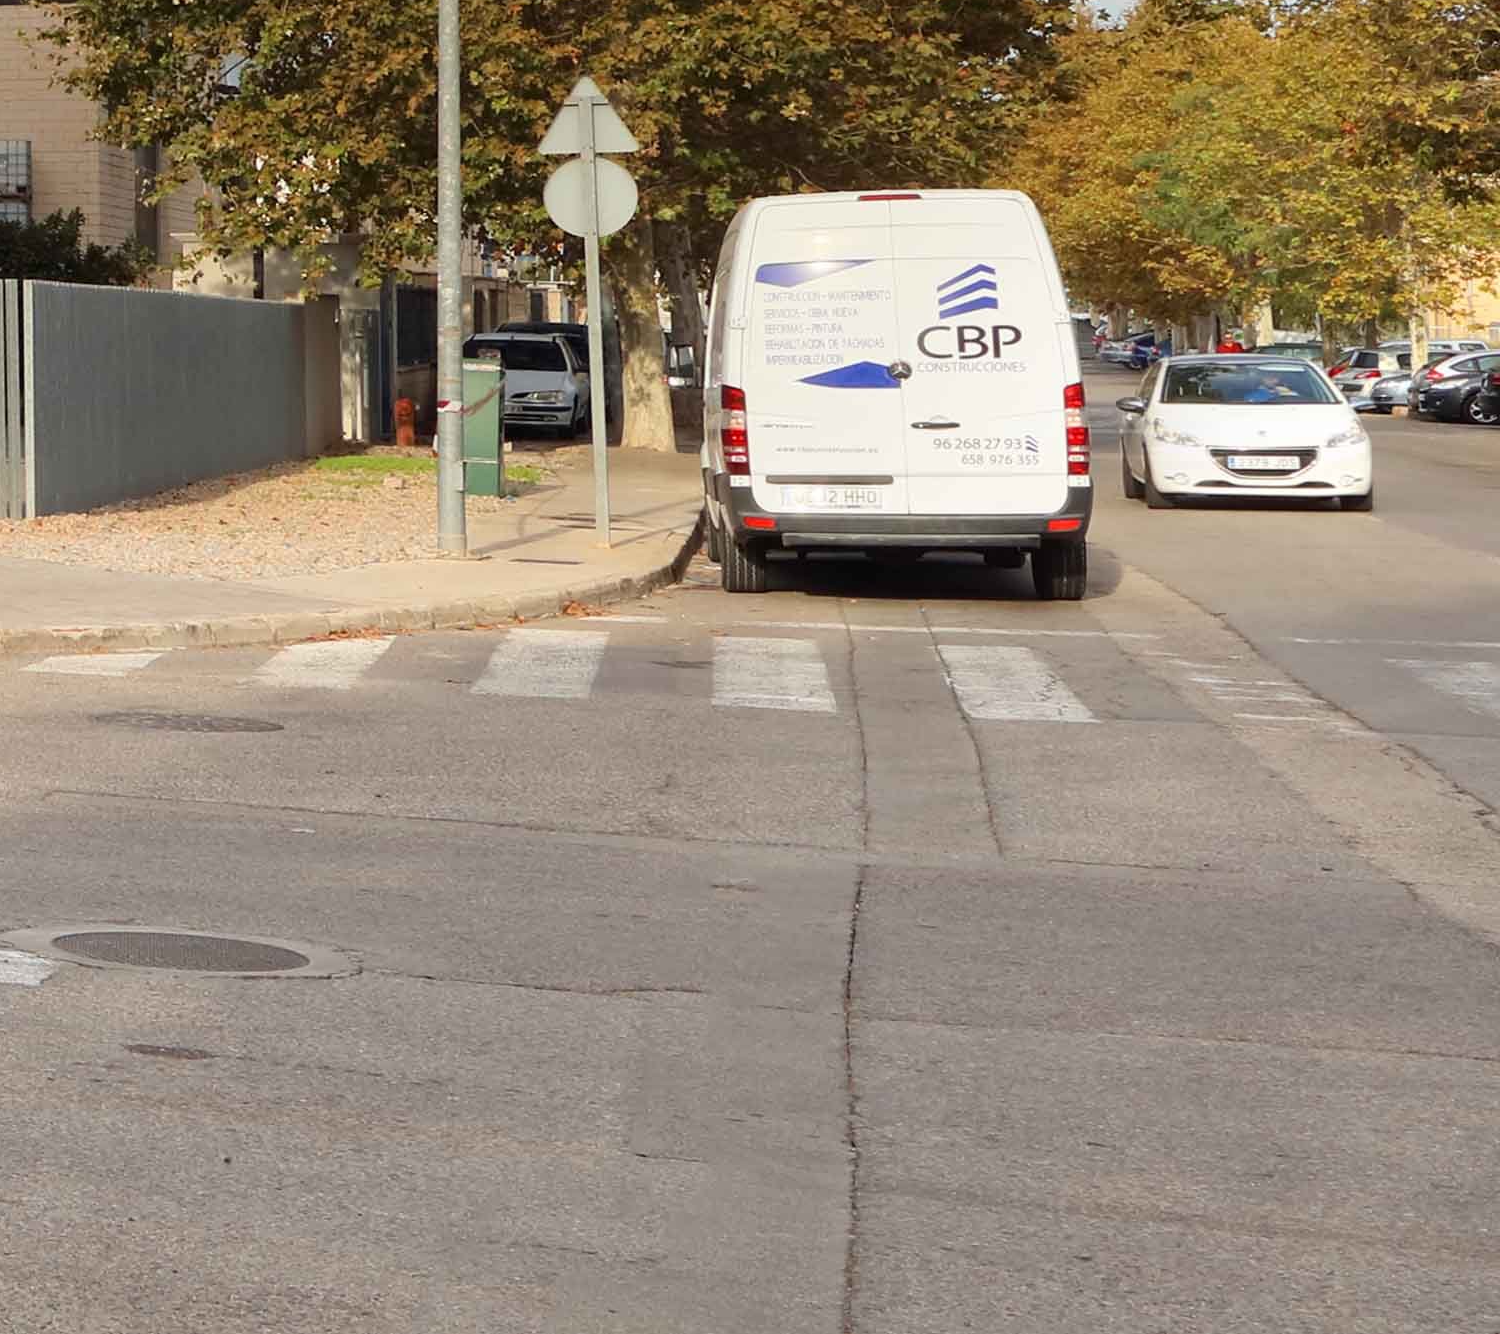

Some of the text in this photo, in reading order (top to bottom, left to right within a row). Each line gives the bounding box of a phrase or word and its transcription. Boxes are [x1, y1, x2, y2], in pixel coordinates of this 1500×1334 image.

[917, 324, 1022, 360] CBP
[916, 361, 1027, 373] CONSTRUCCIONES
[933, 437, 1022, 450] 96 268 27 93
[961, 454, 984, 465] 658
